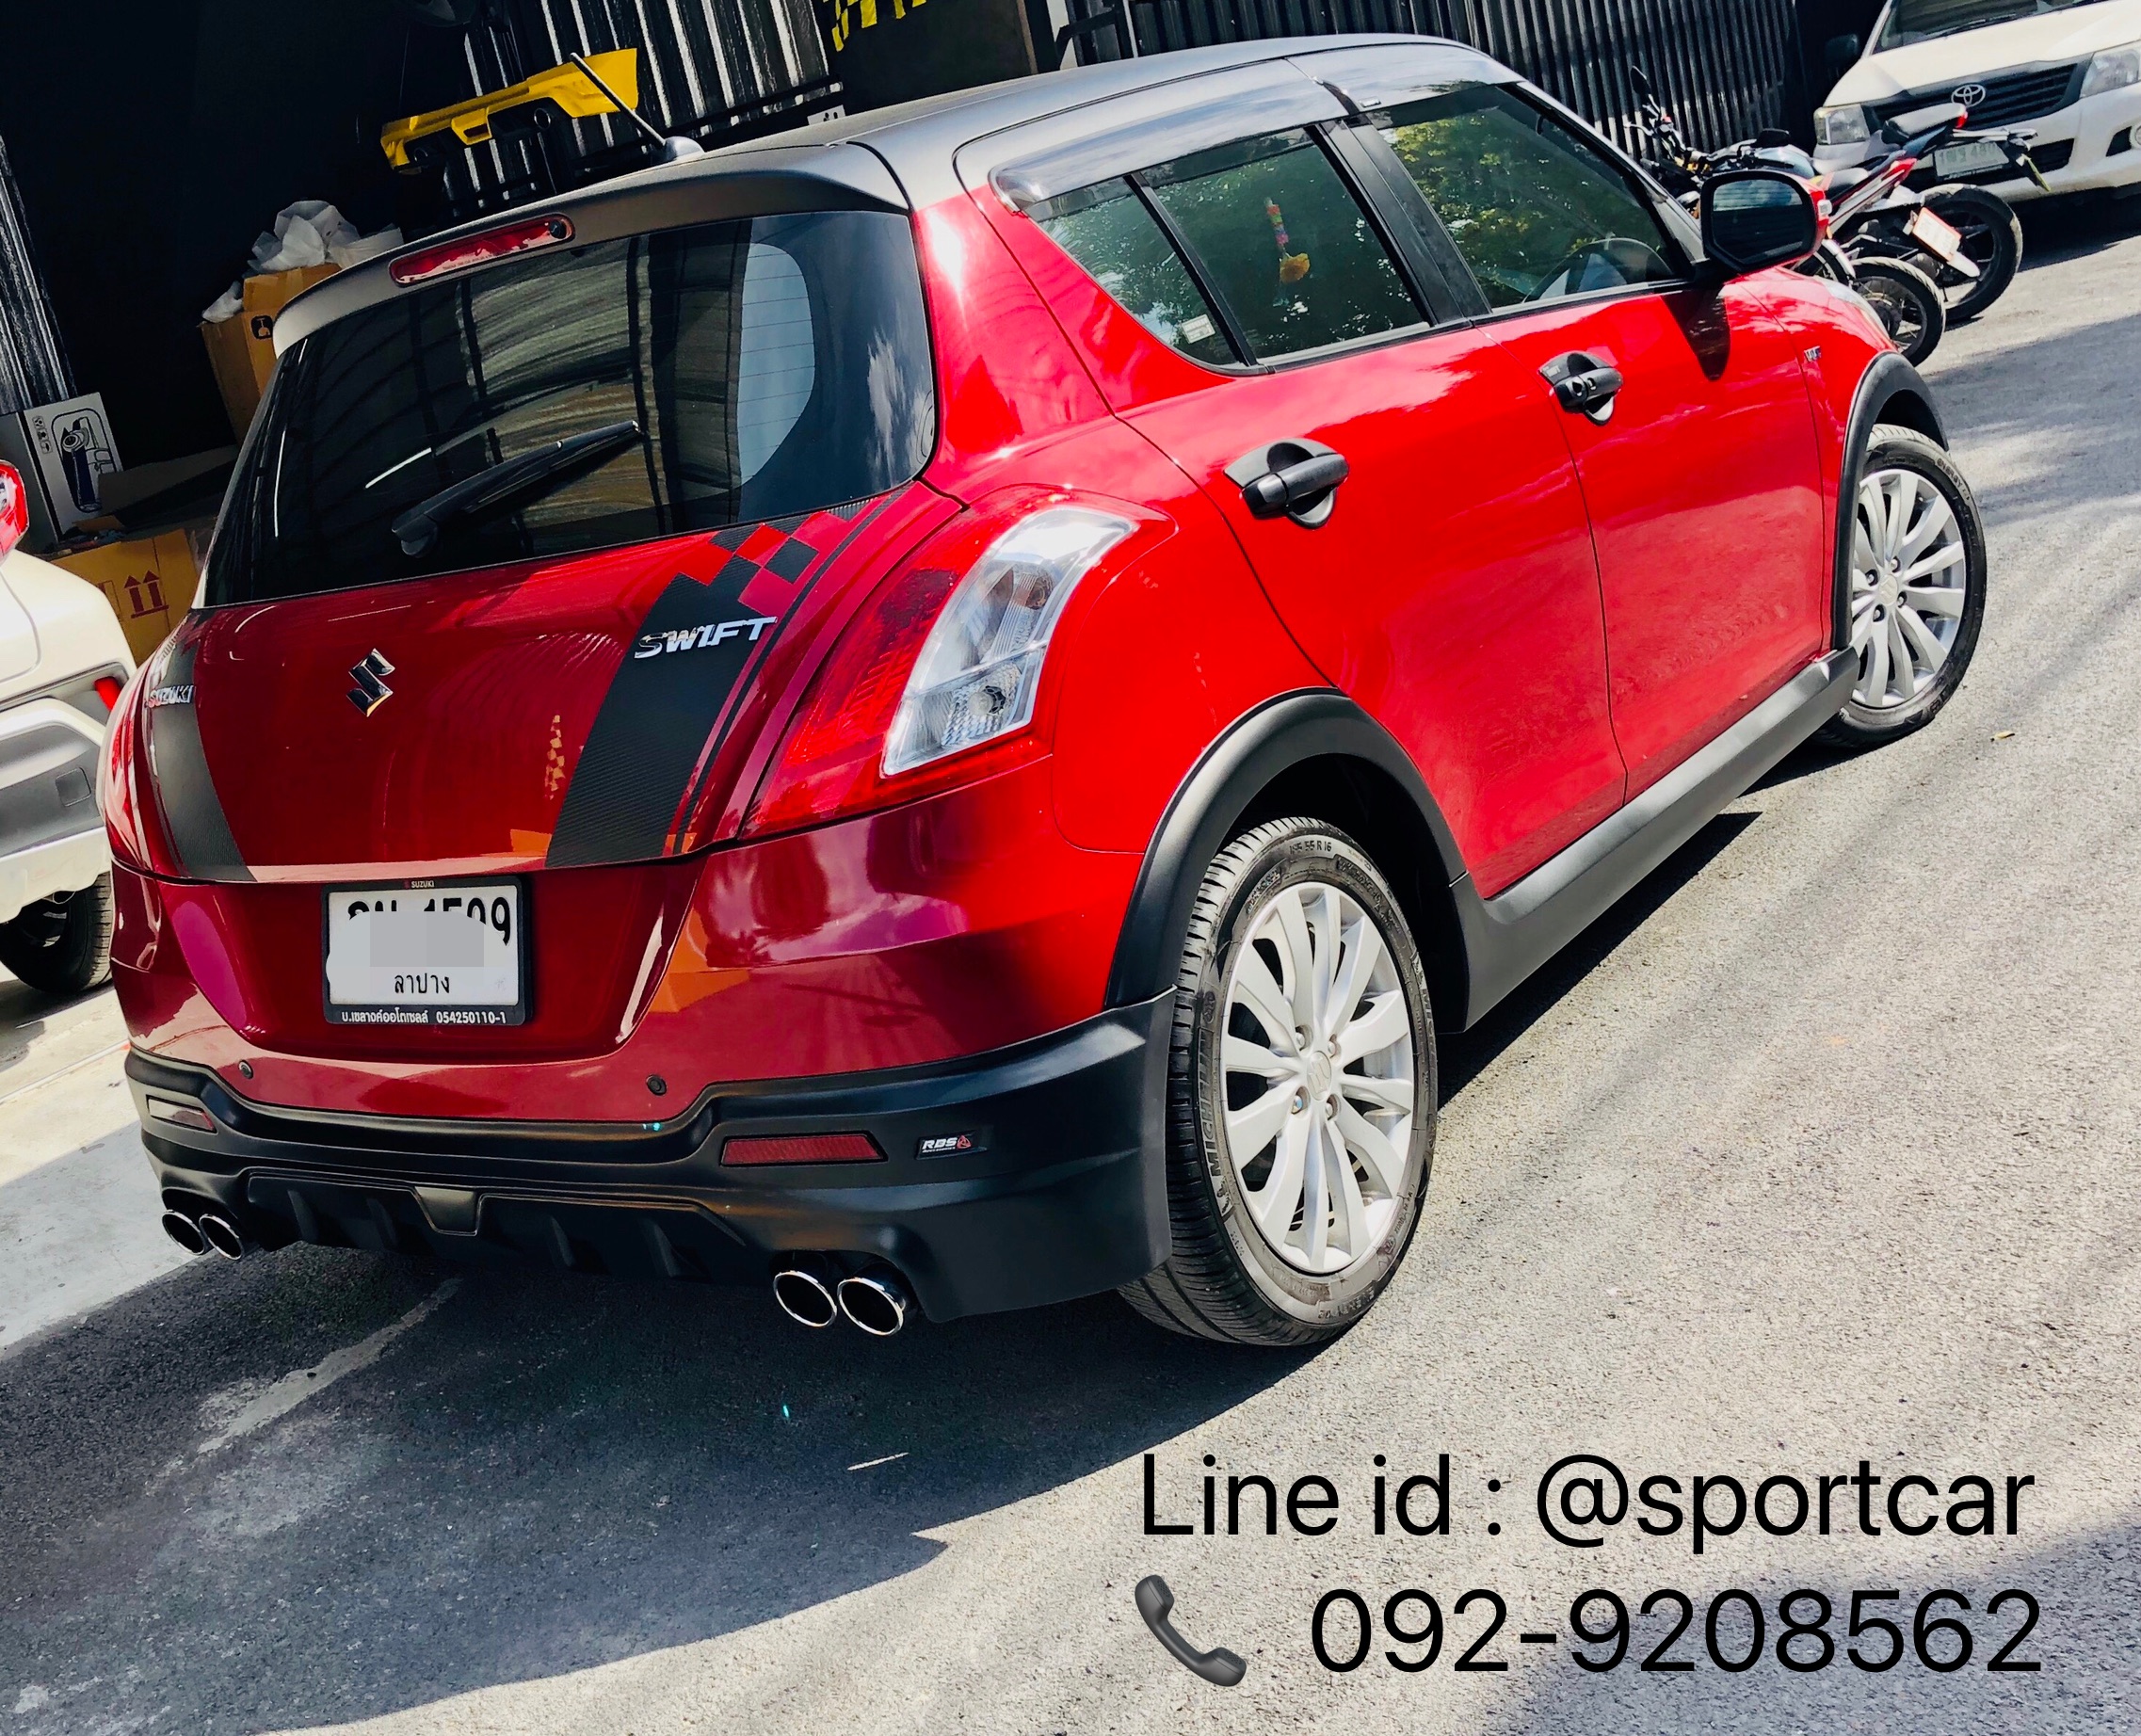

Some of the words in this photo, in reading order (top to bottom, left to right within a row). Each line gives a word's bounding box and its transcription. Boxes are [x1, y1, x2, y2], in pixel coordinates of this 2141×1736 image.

[634, 617, 778, 659] SWIFT
[148, 684, 194, 708] SUZUKI
[410, 880, 435, 889] SUZUKI
[435, 1011, 507, 1024] 054250110-1
[922, 1137, 958, 1149] RBS
